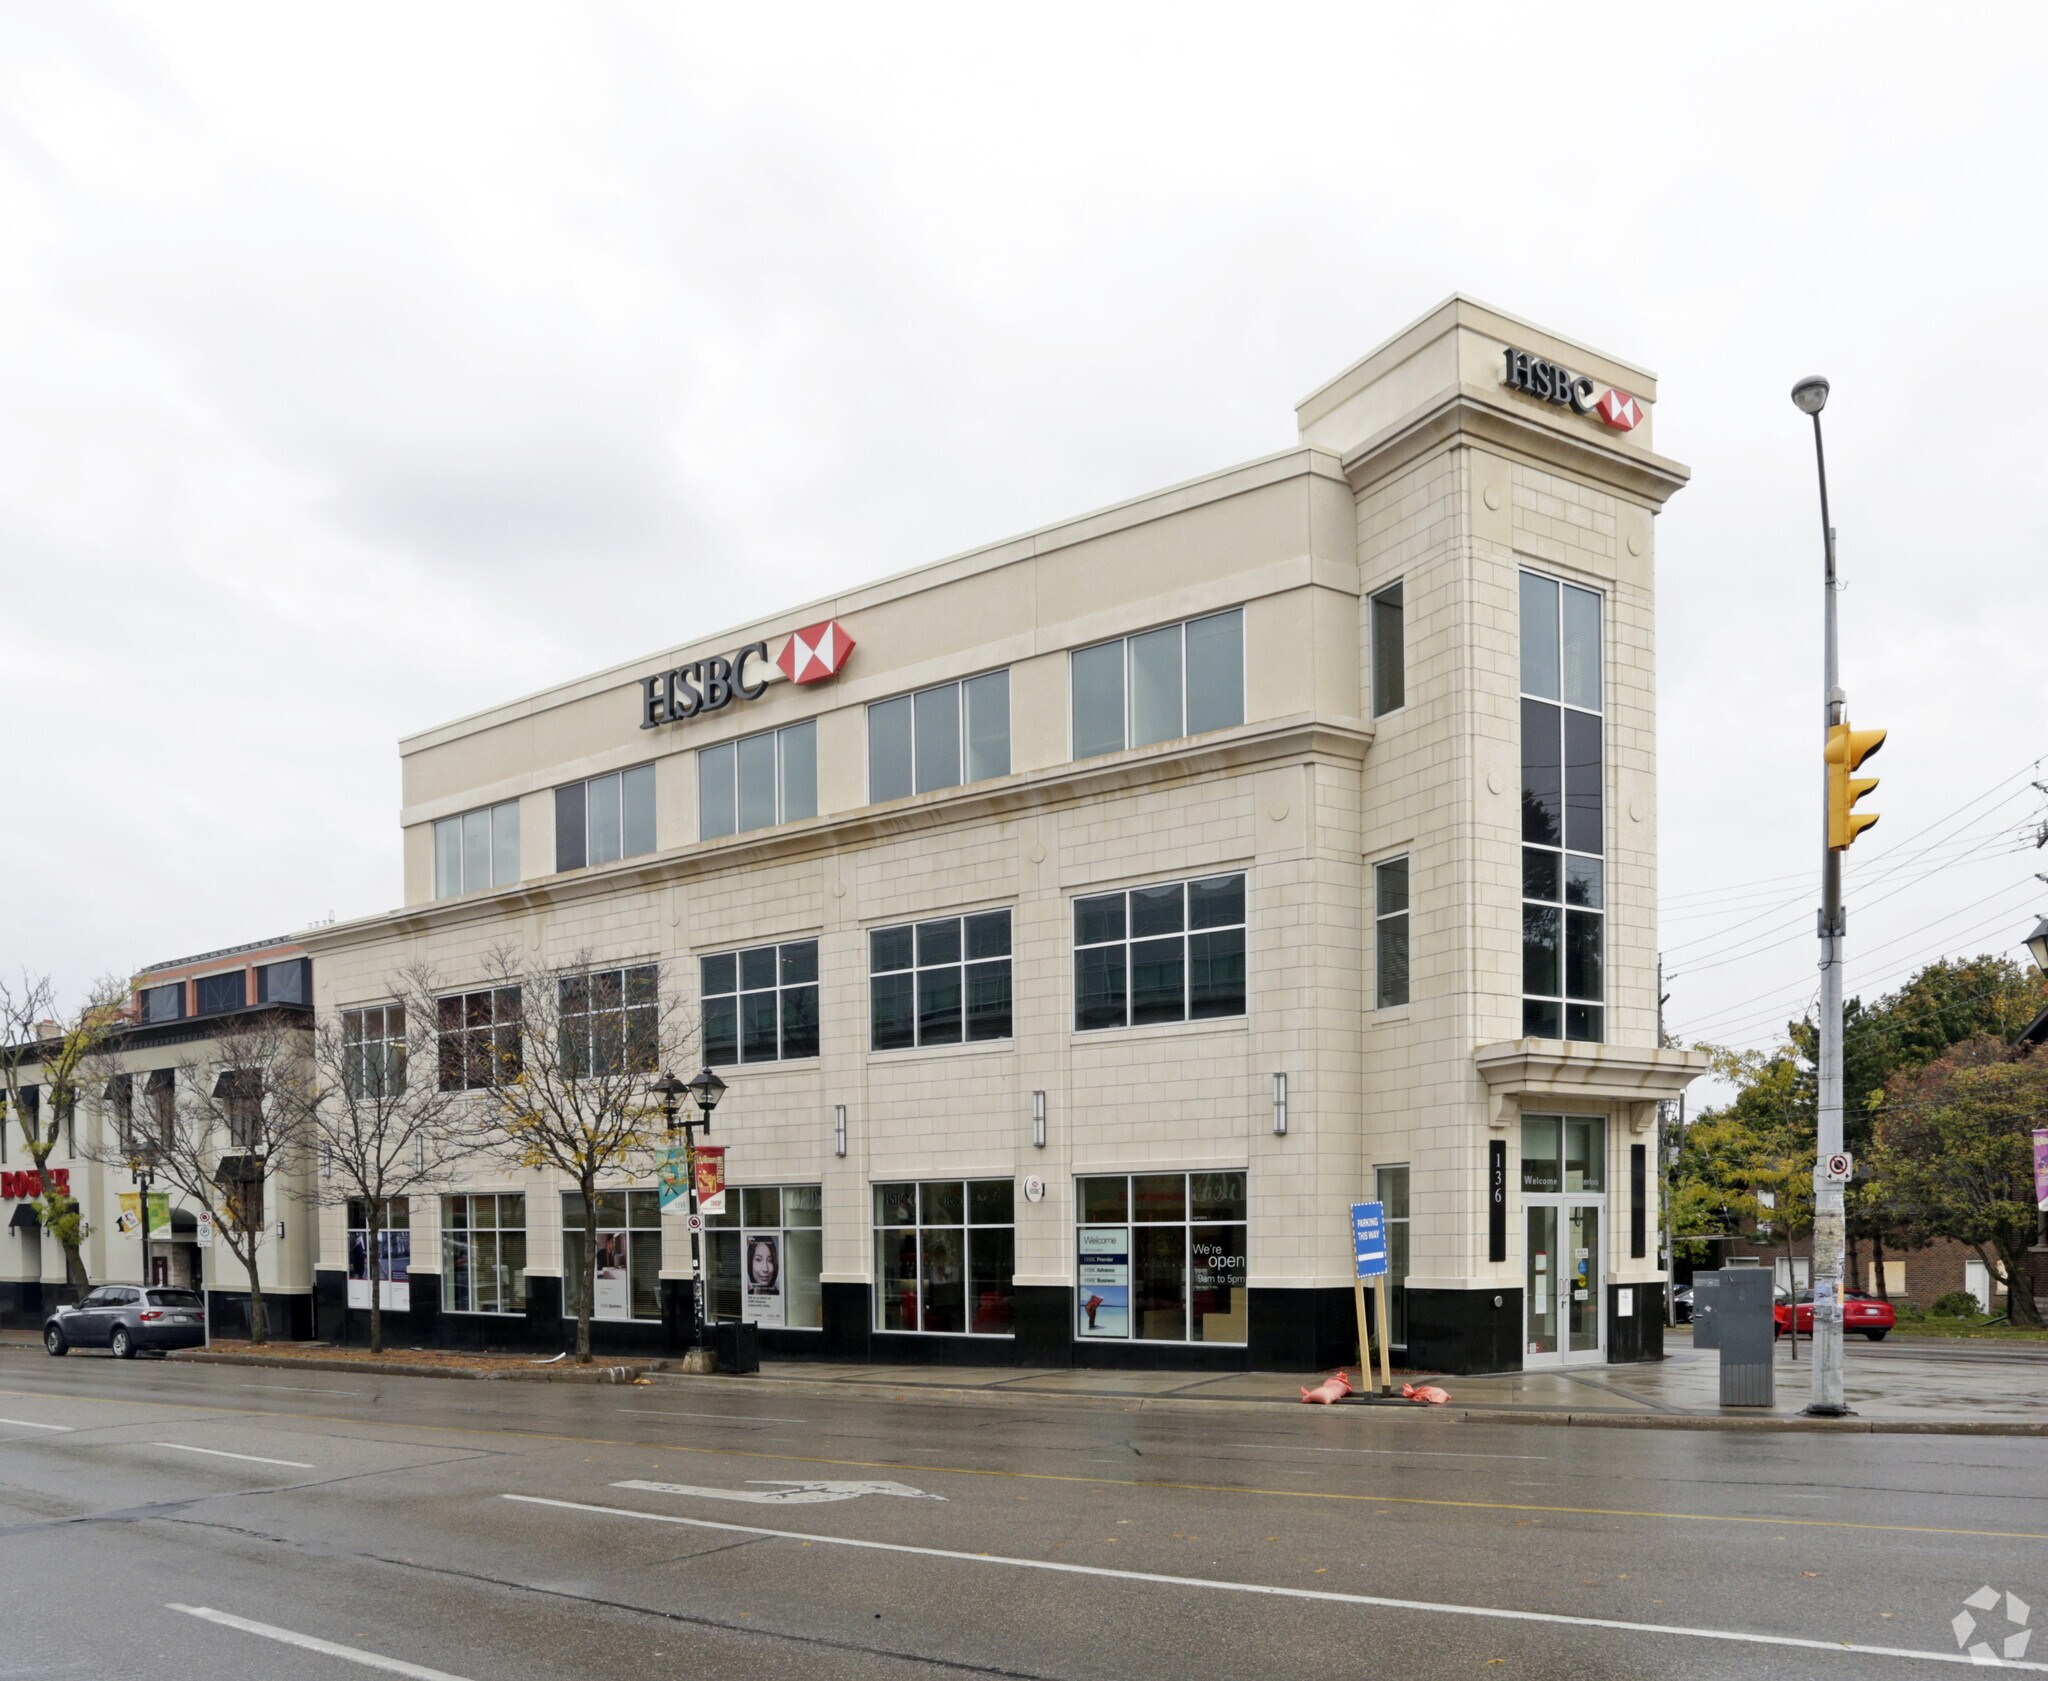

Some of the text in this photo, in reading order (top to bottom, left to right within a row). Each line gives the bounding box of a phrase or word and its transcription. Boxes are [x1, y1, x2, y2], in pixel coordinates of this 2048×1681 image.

[1503, 348, 1595, 415] HSBC
[639, 641, 769, 730] HSBC
[1494, 1153, 1502, 1203] 136
[1524, 1175, 1558, 1185] Welcome
[1357, 1217, 1379, 1228] PARKING
[1084, 1235, 1116, 1245] Welcome
[1358, 1230, 1380, 1241] THIS WAY
[1193, 1244, 1222, 1255] We're
[1208, 1256, 1245, 1271] open
[1197, 1273, 1246, 1285] 9am to 5pm
